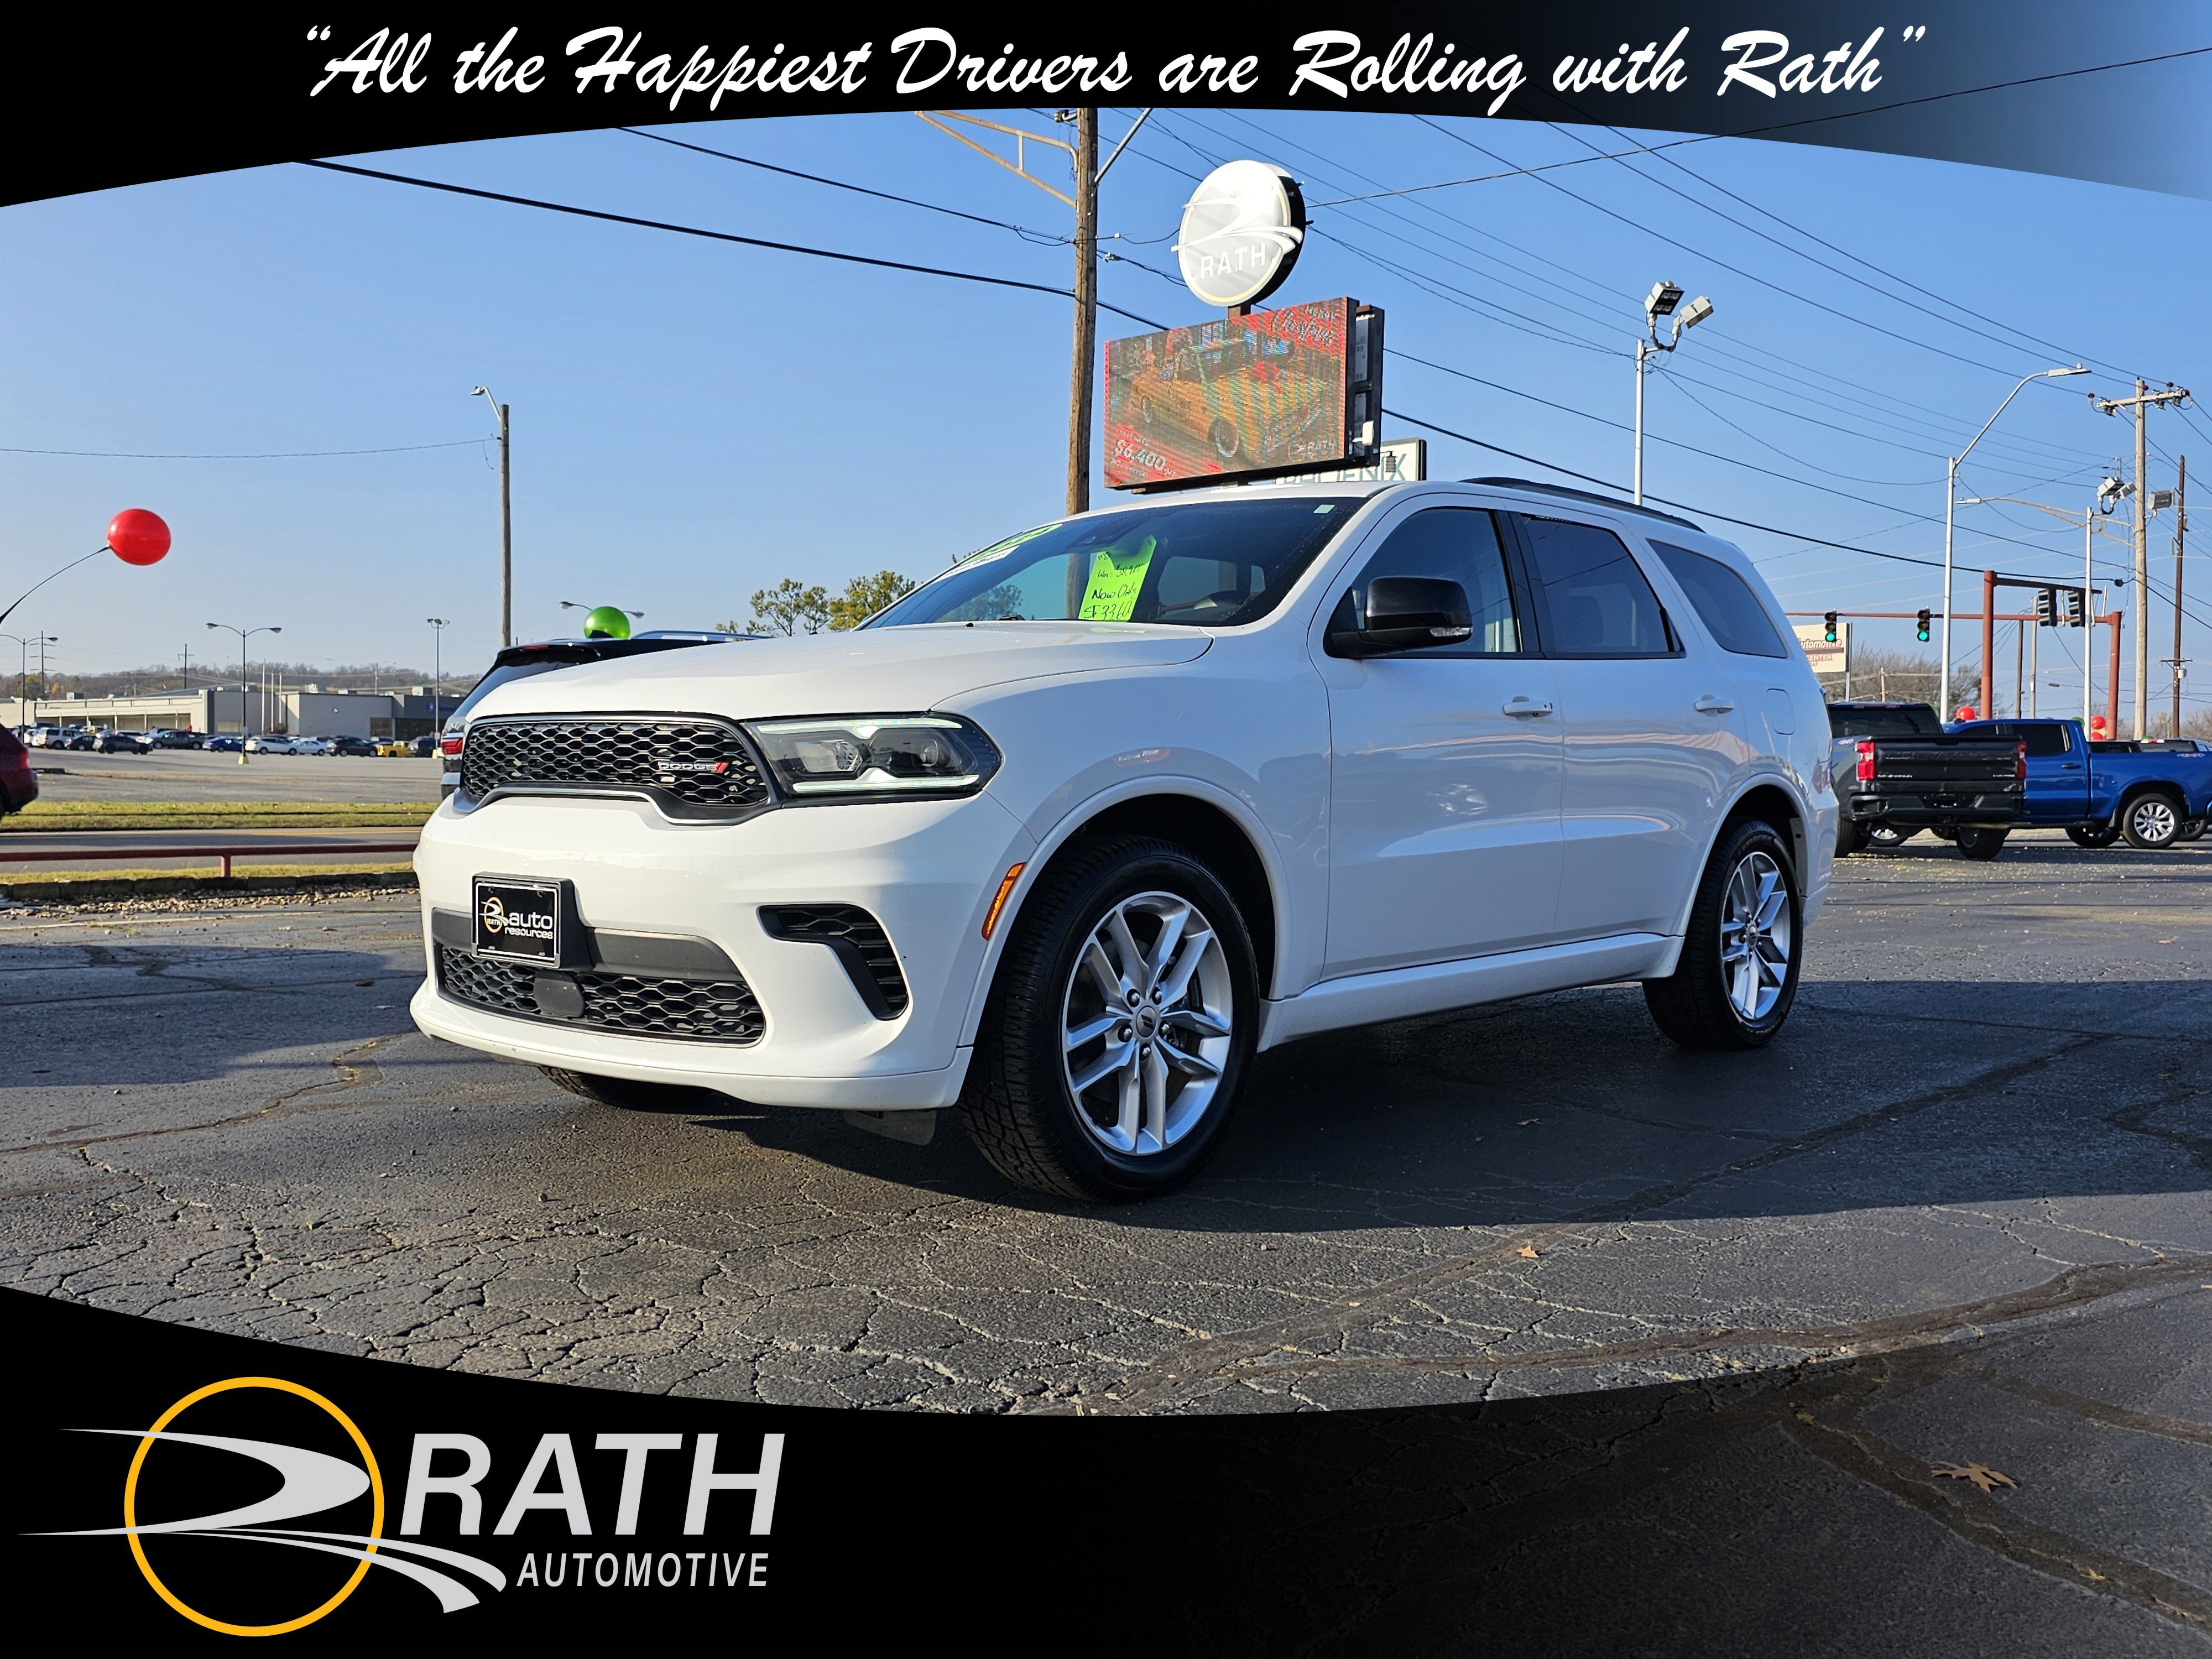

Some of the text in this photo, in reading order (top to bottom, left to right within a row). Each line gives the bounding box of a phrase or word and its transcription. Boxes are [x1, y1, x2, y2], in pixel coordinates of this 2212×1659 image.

[1199, 242, 1265, 279] RATH
[1092, 588, 1115, 599] Now
[658, 761, 718, 773] DODGE
[509, 911, 553, 930] auto
[504, 927, 553, 940] resources
